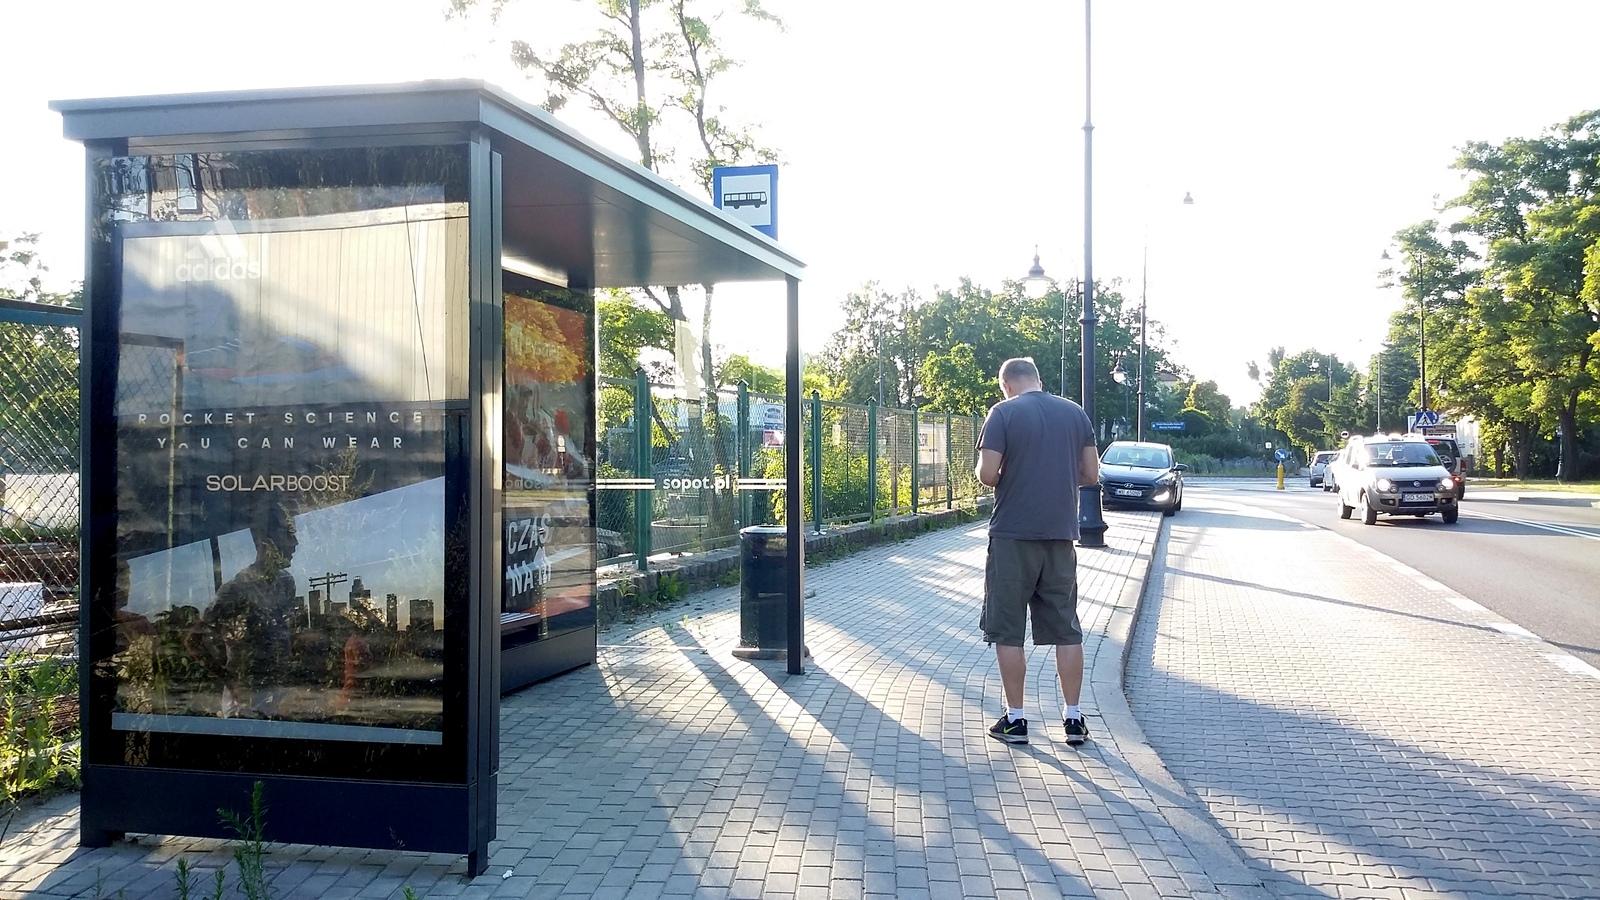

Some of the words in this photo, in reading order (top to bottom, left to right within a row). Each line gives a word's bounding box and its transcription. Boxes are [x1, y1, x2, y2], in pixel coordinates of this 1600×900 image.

[176, 256, 261, 281] adidas
[138, 412, 255, 424] ROCKET
[284, 411, 422, 424] SCIENCE
[237, 437, 294, 449] CAN
[322, 437, 402, 449] WEAR
[206, 474, 350, 492] SOLARBOOST
[662, 474, 730, 496] sopot.pl
[507, 512, 552, 555] CZAS
[506, 560, 534, 597] NA
